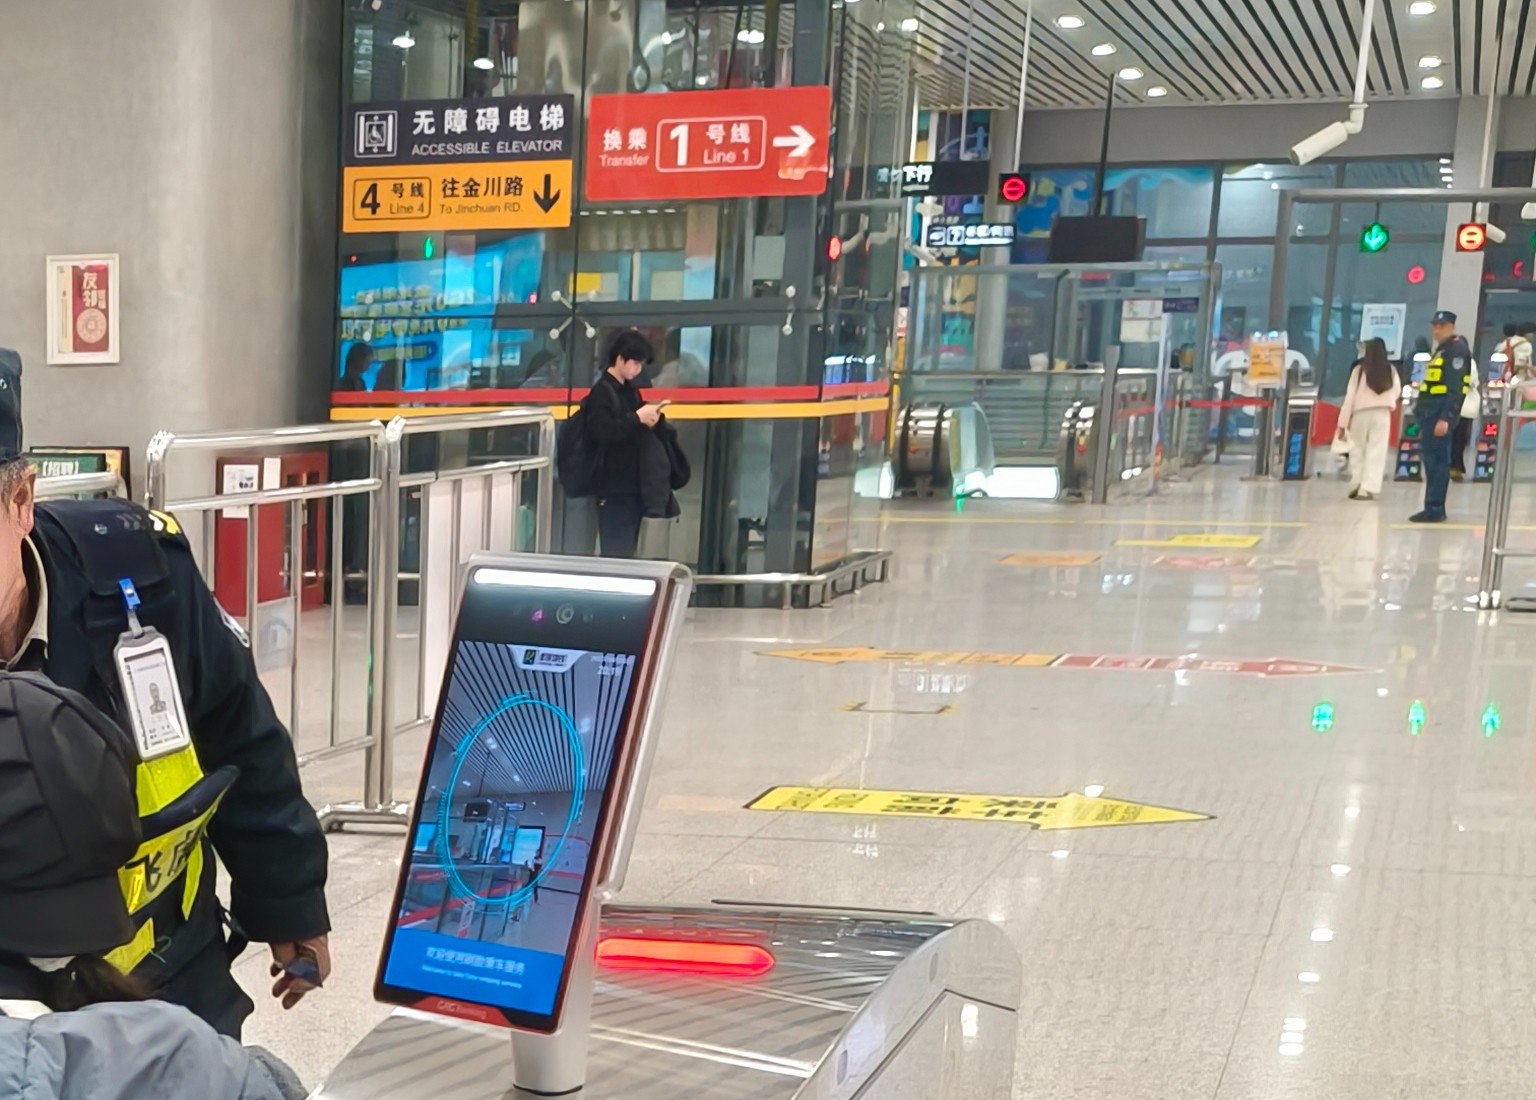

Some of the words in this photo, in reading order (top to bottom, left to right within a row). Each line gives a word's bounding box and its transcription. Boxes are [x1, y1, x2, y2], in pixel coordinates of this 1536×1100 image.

[412, 104, 564, 135] 无障碍电梯
[411, 141, 490, 157] ACCESSIBLE
[496, 139, 563, 154] ELEVATOR
[602, 127, 648, 151] 换乘
[669, 124, 689, 166] 1
[705, 123, 751, 145] 号线
[598, 153, 650, 168] Transfer
[703, 149, 737, 165] Line
[741, 148, 750, 163] 1
[441, 176, 524, 199] 往金川路
[360, 182, 381, 215] 4
[391, 183, 425, 199] 号线
[389, 203, 414, 215] Line
[417, 202, 425, 214] 4
[439, 204, 453, 215] To
[455, 203, 501, 215] Jinchuan
